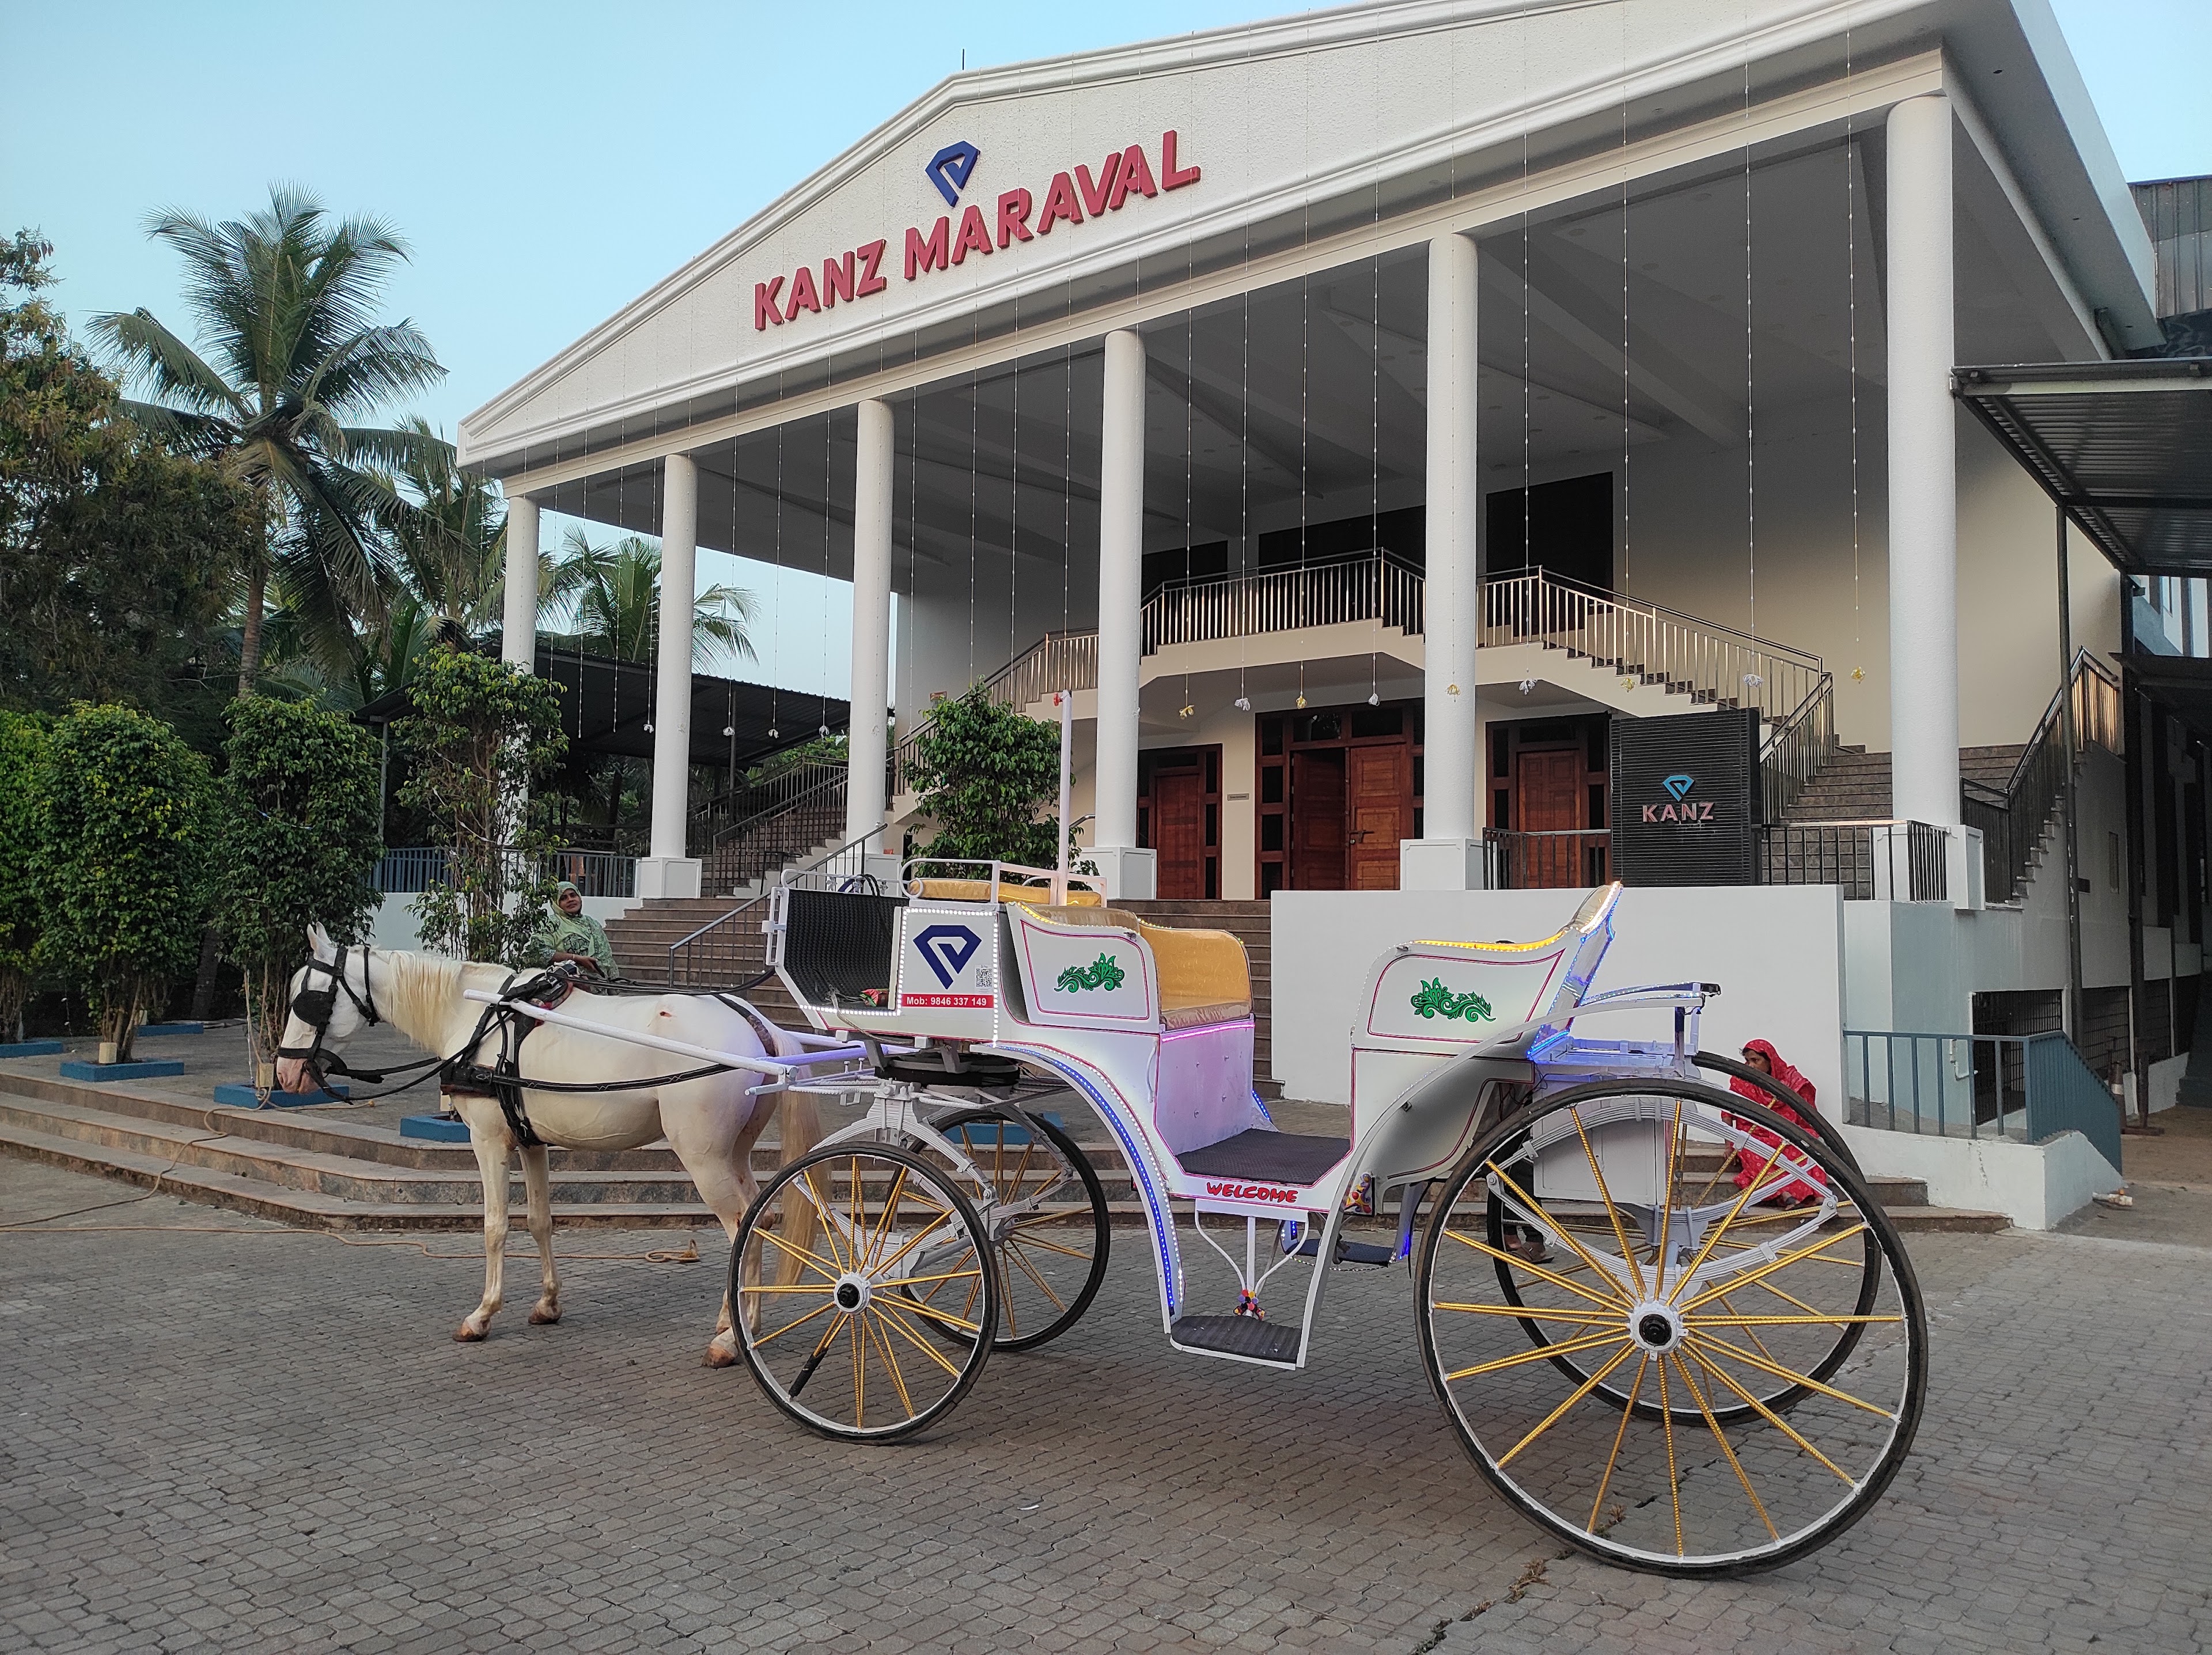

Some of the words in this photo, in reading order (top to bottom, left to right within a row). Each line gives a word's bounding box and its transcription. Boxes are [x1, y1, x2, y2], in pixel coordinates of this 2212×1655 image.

[755, 239, 887, 330] KANZ
[904, 130, 1201, 280] MARAVAL
[1642, 802, 1715, 823] KANZ
[907, 997, 928, 1005] Mob:
[930, 997, 951, 1006] 9846
[953, 997, 969, 1006] 337
[971, 998, 987, 1006] 149
[1207, 1182, 1298, 1203] WELCOME
